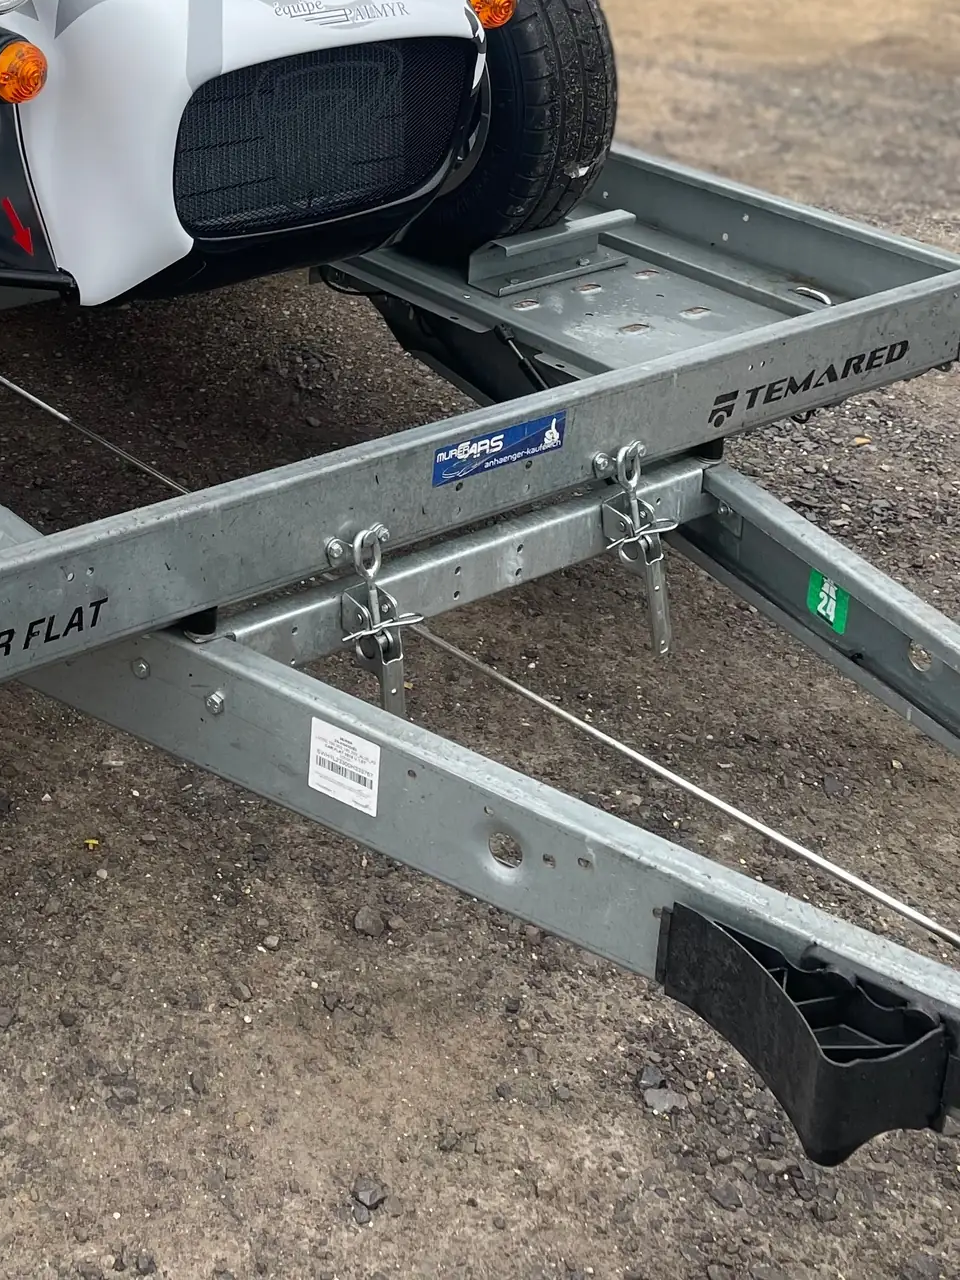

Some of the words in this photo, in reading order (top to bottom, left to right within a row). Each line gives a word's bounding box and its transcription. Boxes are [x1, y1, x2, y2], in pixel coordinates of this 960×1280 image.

[274, 0, 324, 19] équipe
[342, 0, 411, 22] PALMYR
[745, 339, 910, 411] TEMARED
[22, 596, 109, 651] FLAT
